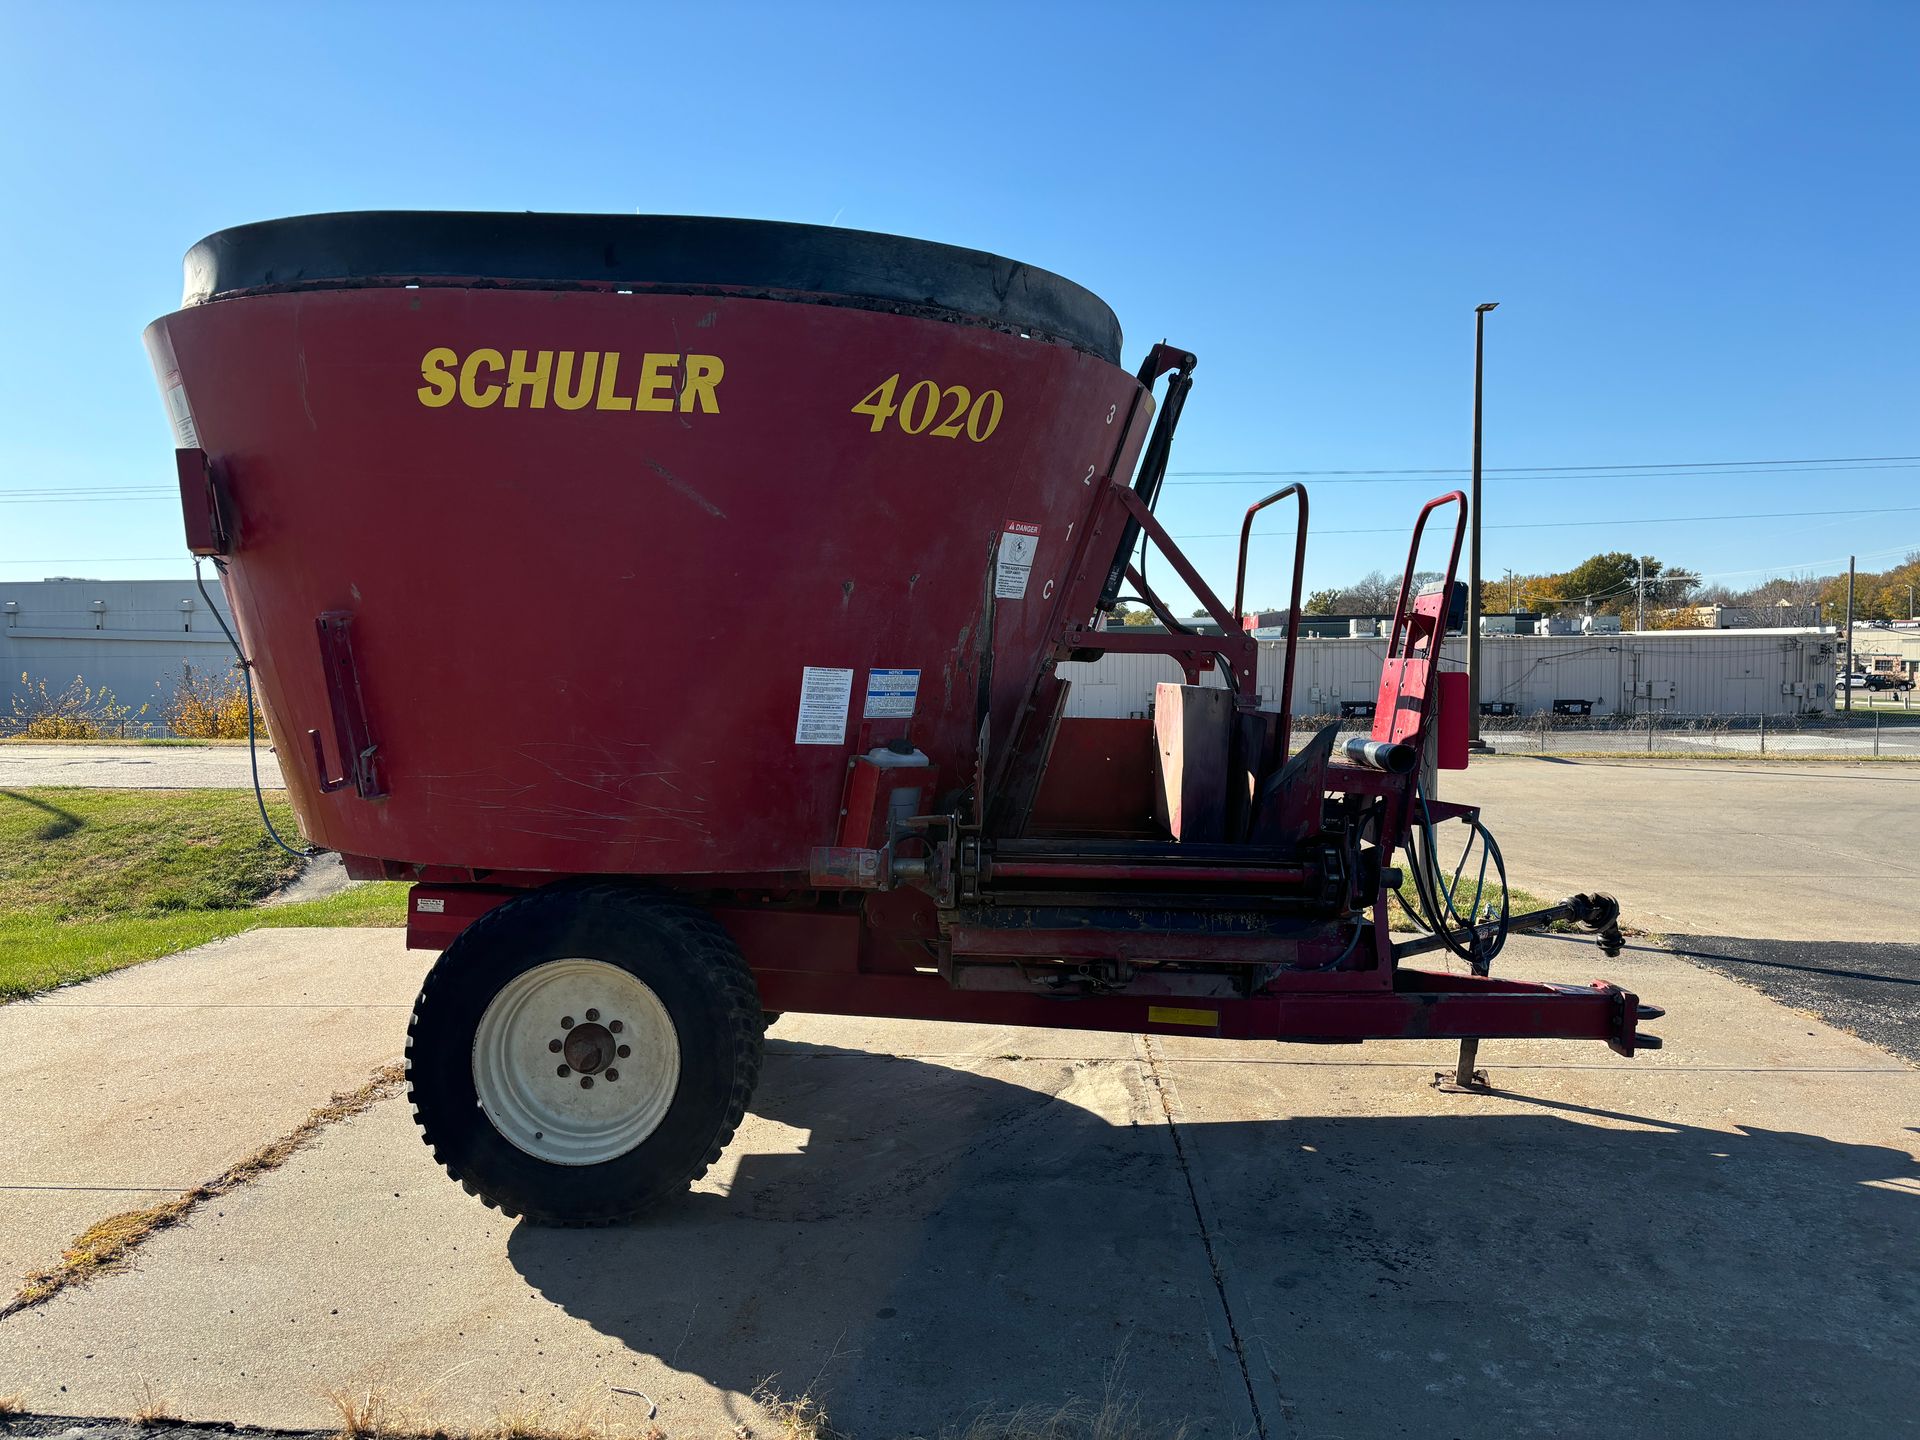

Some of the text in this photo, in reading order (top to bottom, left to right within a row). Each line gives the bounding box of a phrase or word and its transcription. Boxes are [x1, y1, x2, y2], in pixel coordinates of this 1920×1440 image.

[417, 347, 724, 414] SCHULER
[851, 373, 1004, 443] 4020
[1106, 404, 1116, 424] 3
[1084, 465, 1095, 486] 2
[1015, 523, 1038, 533] DANGER
[1065, 522, 1074, 541] 1
[1042, 579, 1054, 600] C
